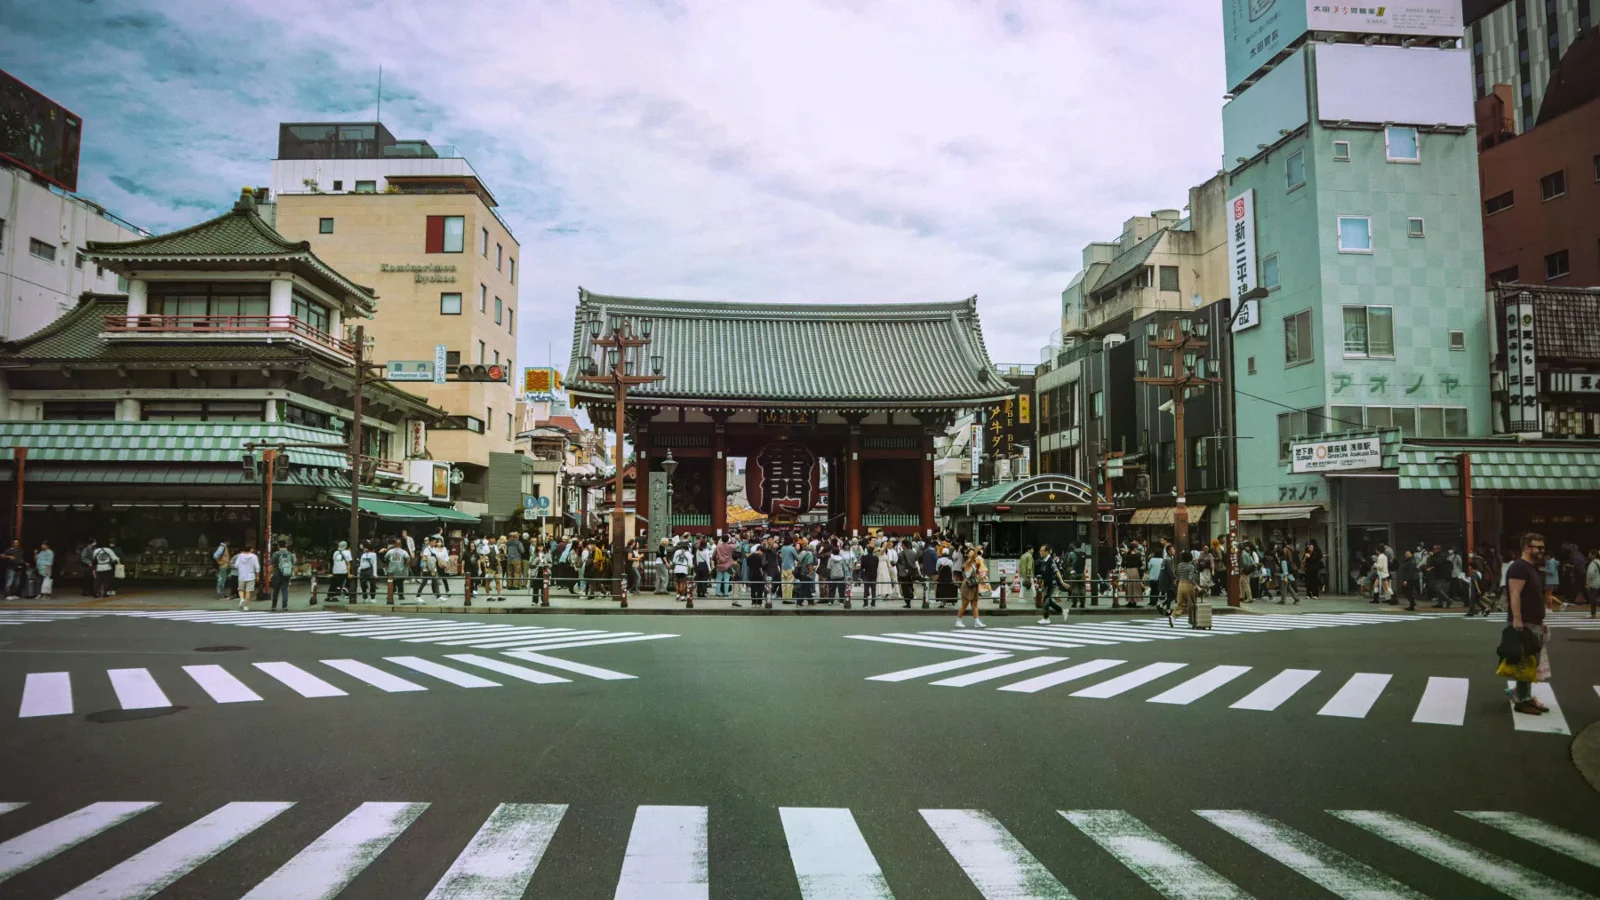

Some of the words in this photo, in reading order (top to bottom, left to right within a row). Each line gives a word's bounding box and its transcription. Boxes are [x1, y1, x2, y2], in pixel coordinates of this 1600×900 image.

[381, 263, 457, 272] Kaminarimon
[415, 272, 457, 284] Ryokan
[1333, 374, 1460, 395] アオノヤ
[1295, 447, 1314, 456] 地下鉄
[1349, 442, 1371, 451] 浅草駅
[1279, 484, 1318, 502] アオノヤ
